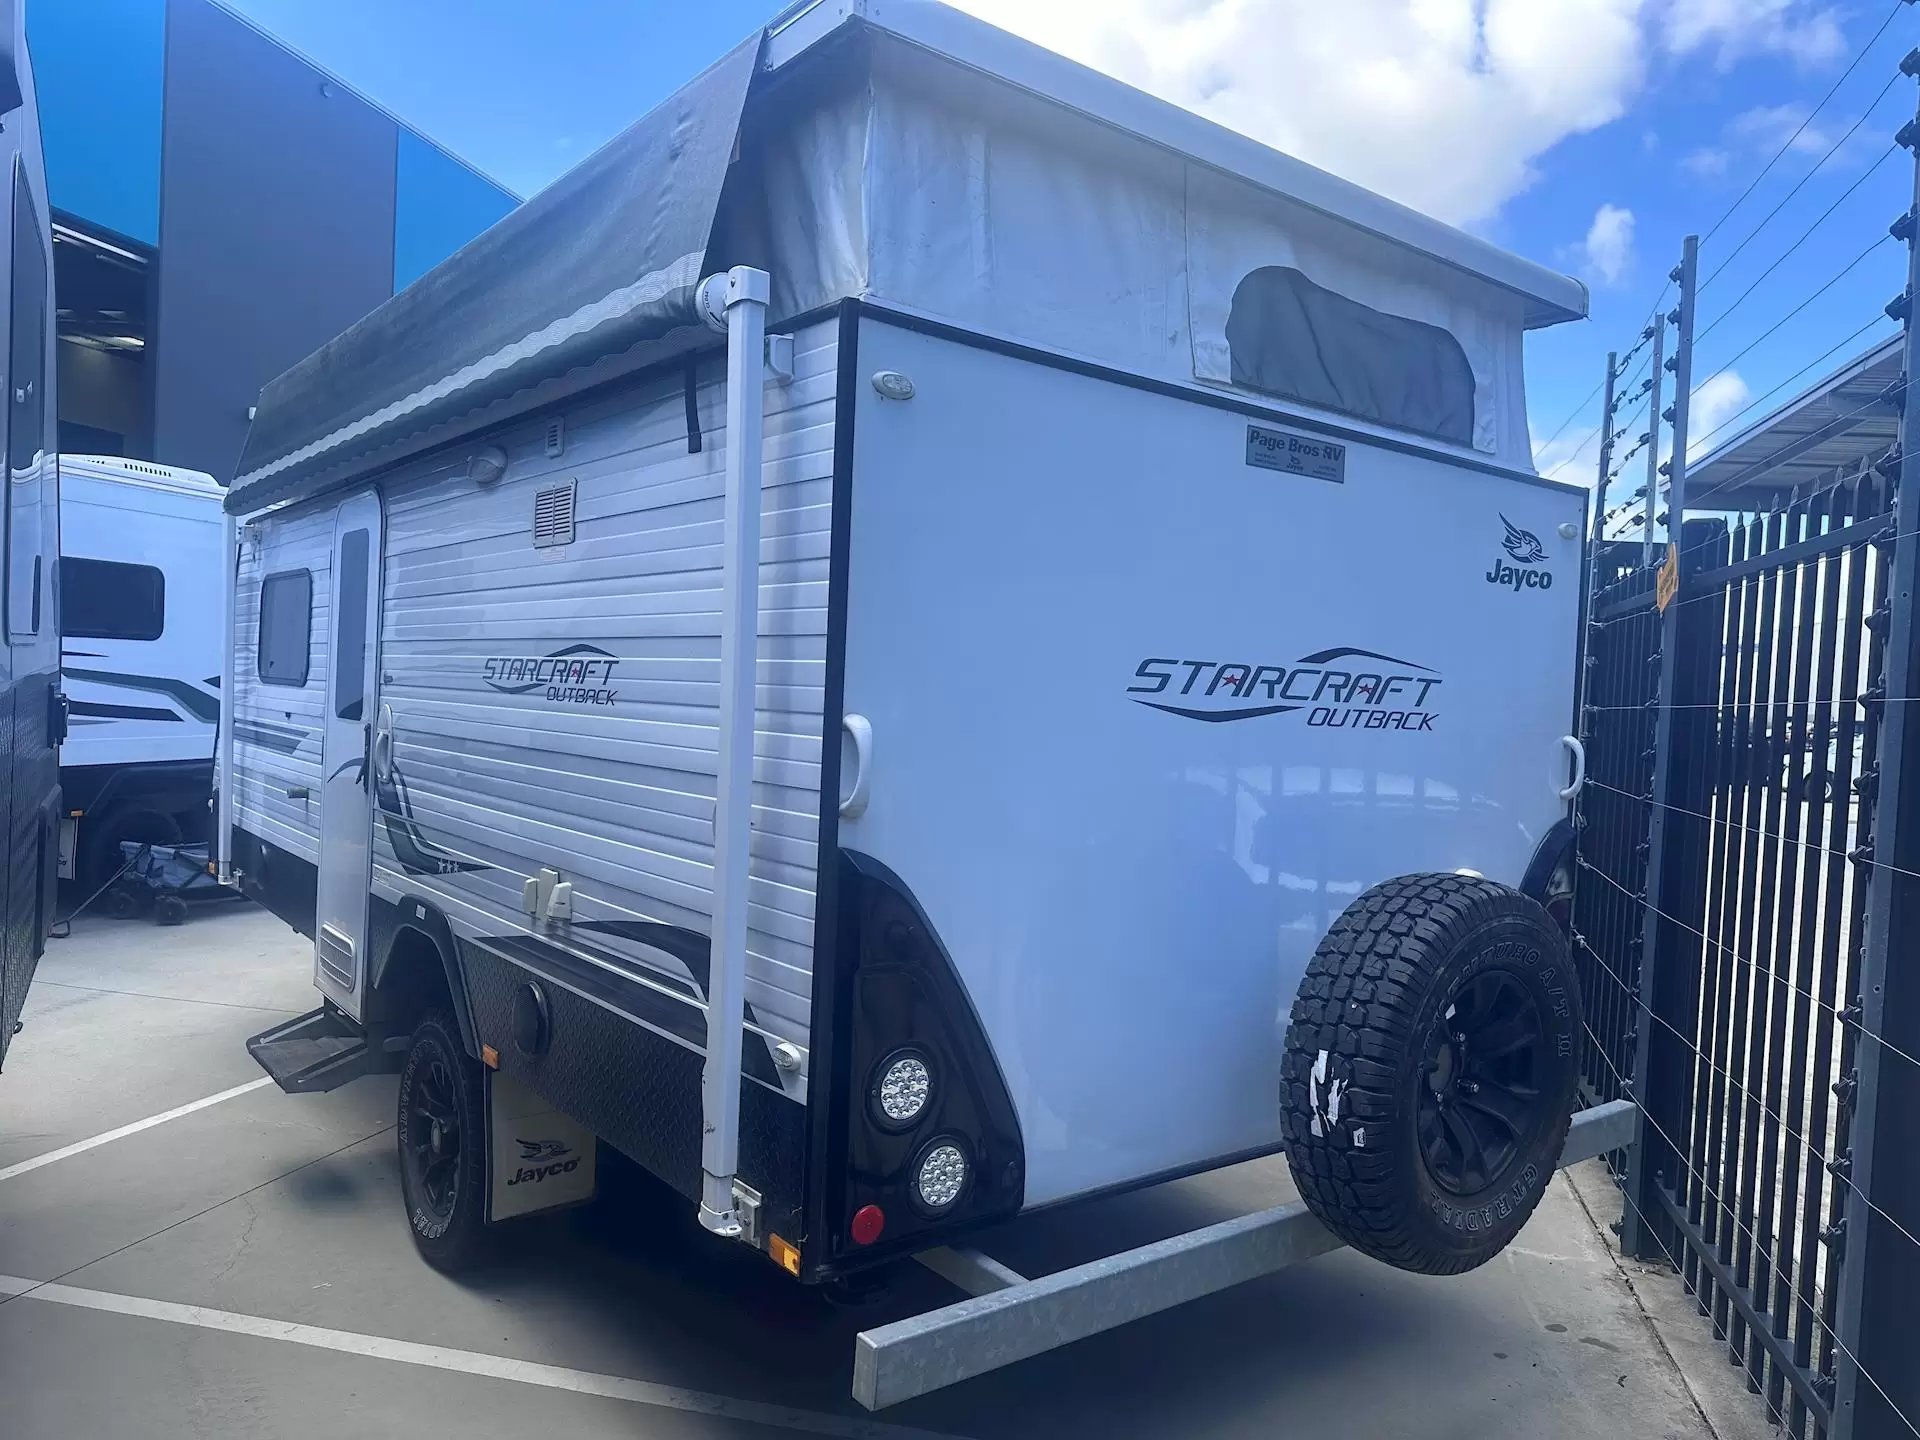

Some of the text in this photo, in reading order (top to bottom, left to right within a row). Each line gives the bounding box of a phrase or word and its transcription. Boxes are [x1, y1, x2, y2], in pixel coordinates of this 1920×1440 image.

[1249, 430, 1343, 461] Page Bros RV
[1486, 558, 1552, 591] Jayco
[482, 657, 620, 686] STARCRAFT
[1126, 658, 1443, 707] STARCRAFT
[546, 686, 619, 706] OUTBACK
[1307, 707, 1440, 731] OUTBACK
[507, 1158, 579, 1186] Jayco
